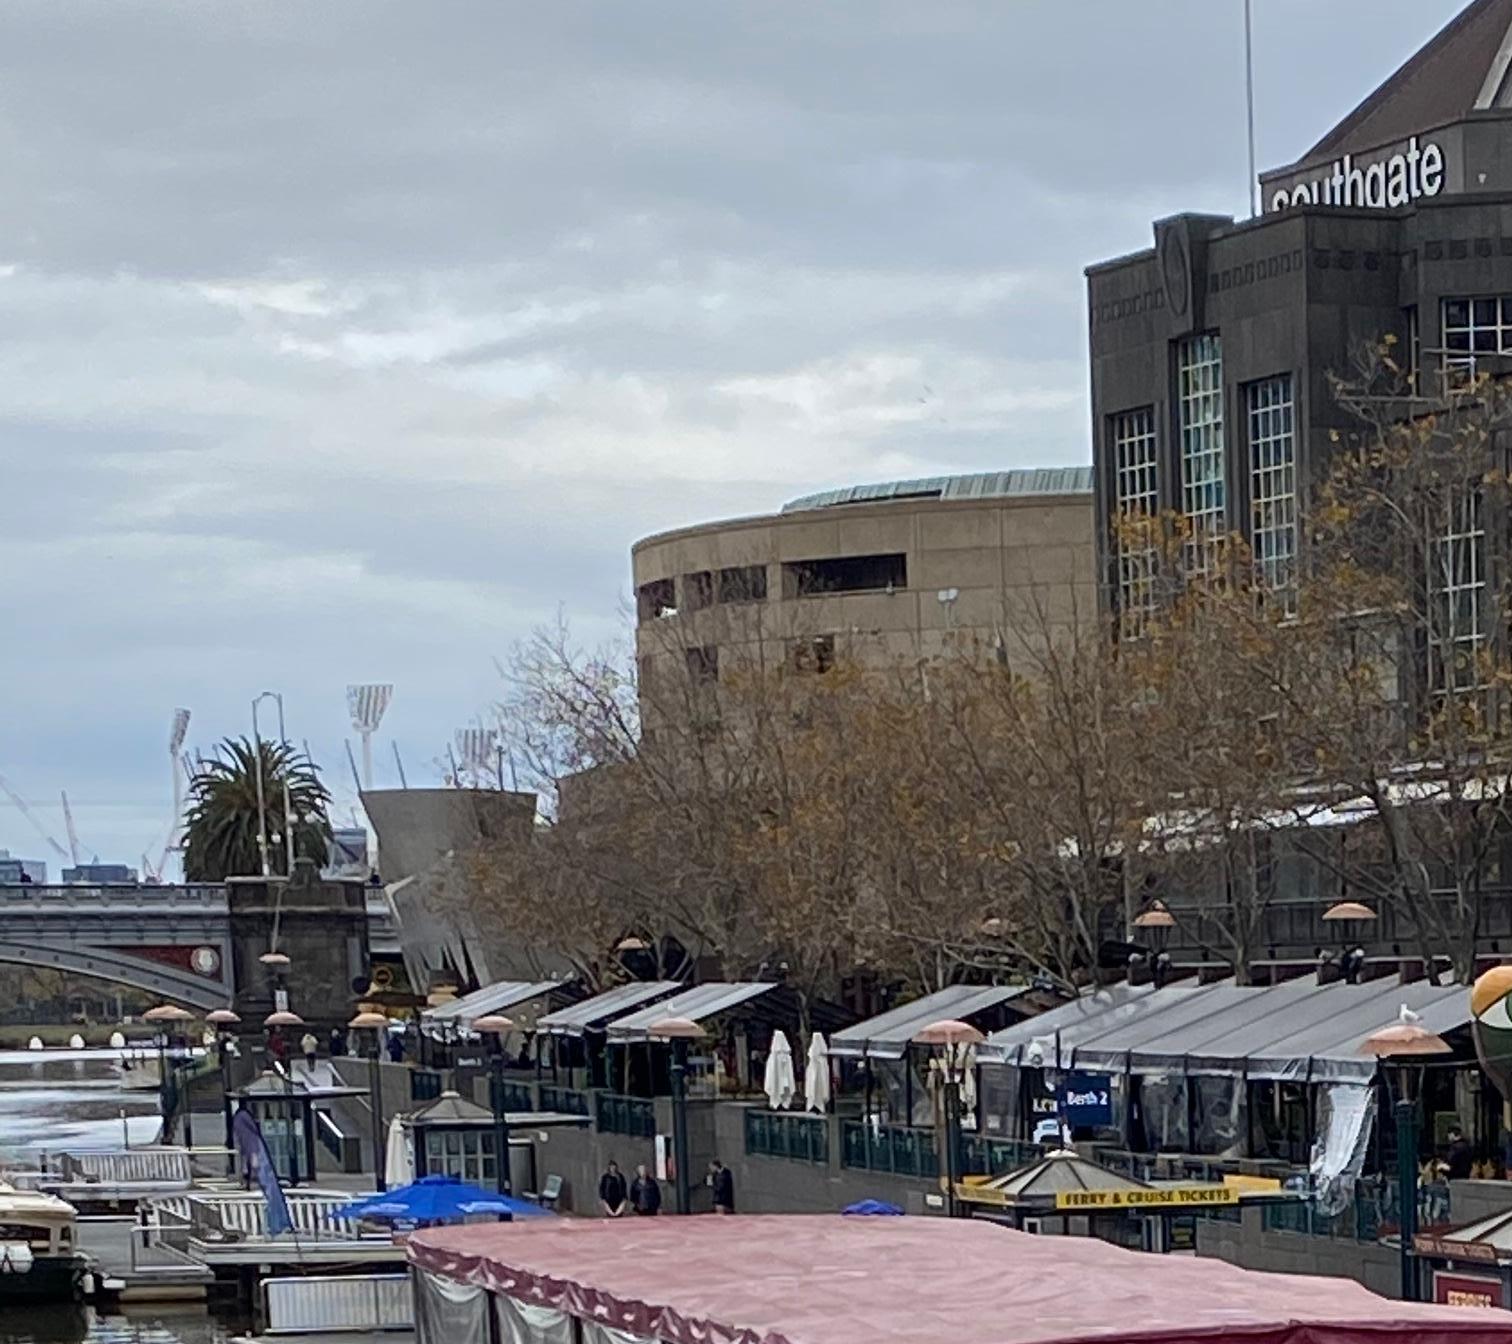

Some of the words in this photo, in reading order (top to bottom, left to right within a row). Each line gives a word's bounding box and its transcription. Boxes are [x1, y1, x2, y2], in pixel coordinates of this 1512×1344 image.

[1067, 1090, 1098, 1105] Berth
[1099, 1090, 1108, 1105] 2
[1065, 1192, 1107, 1206] FERRY
[1112, 1192, 1122, 1205] &
[1127, 1190, 1174, 1205] CRUISE
[1178, 1188, 1231, 1202] TICKETS
